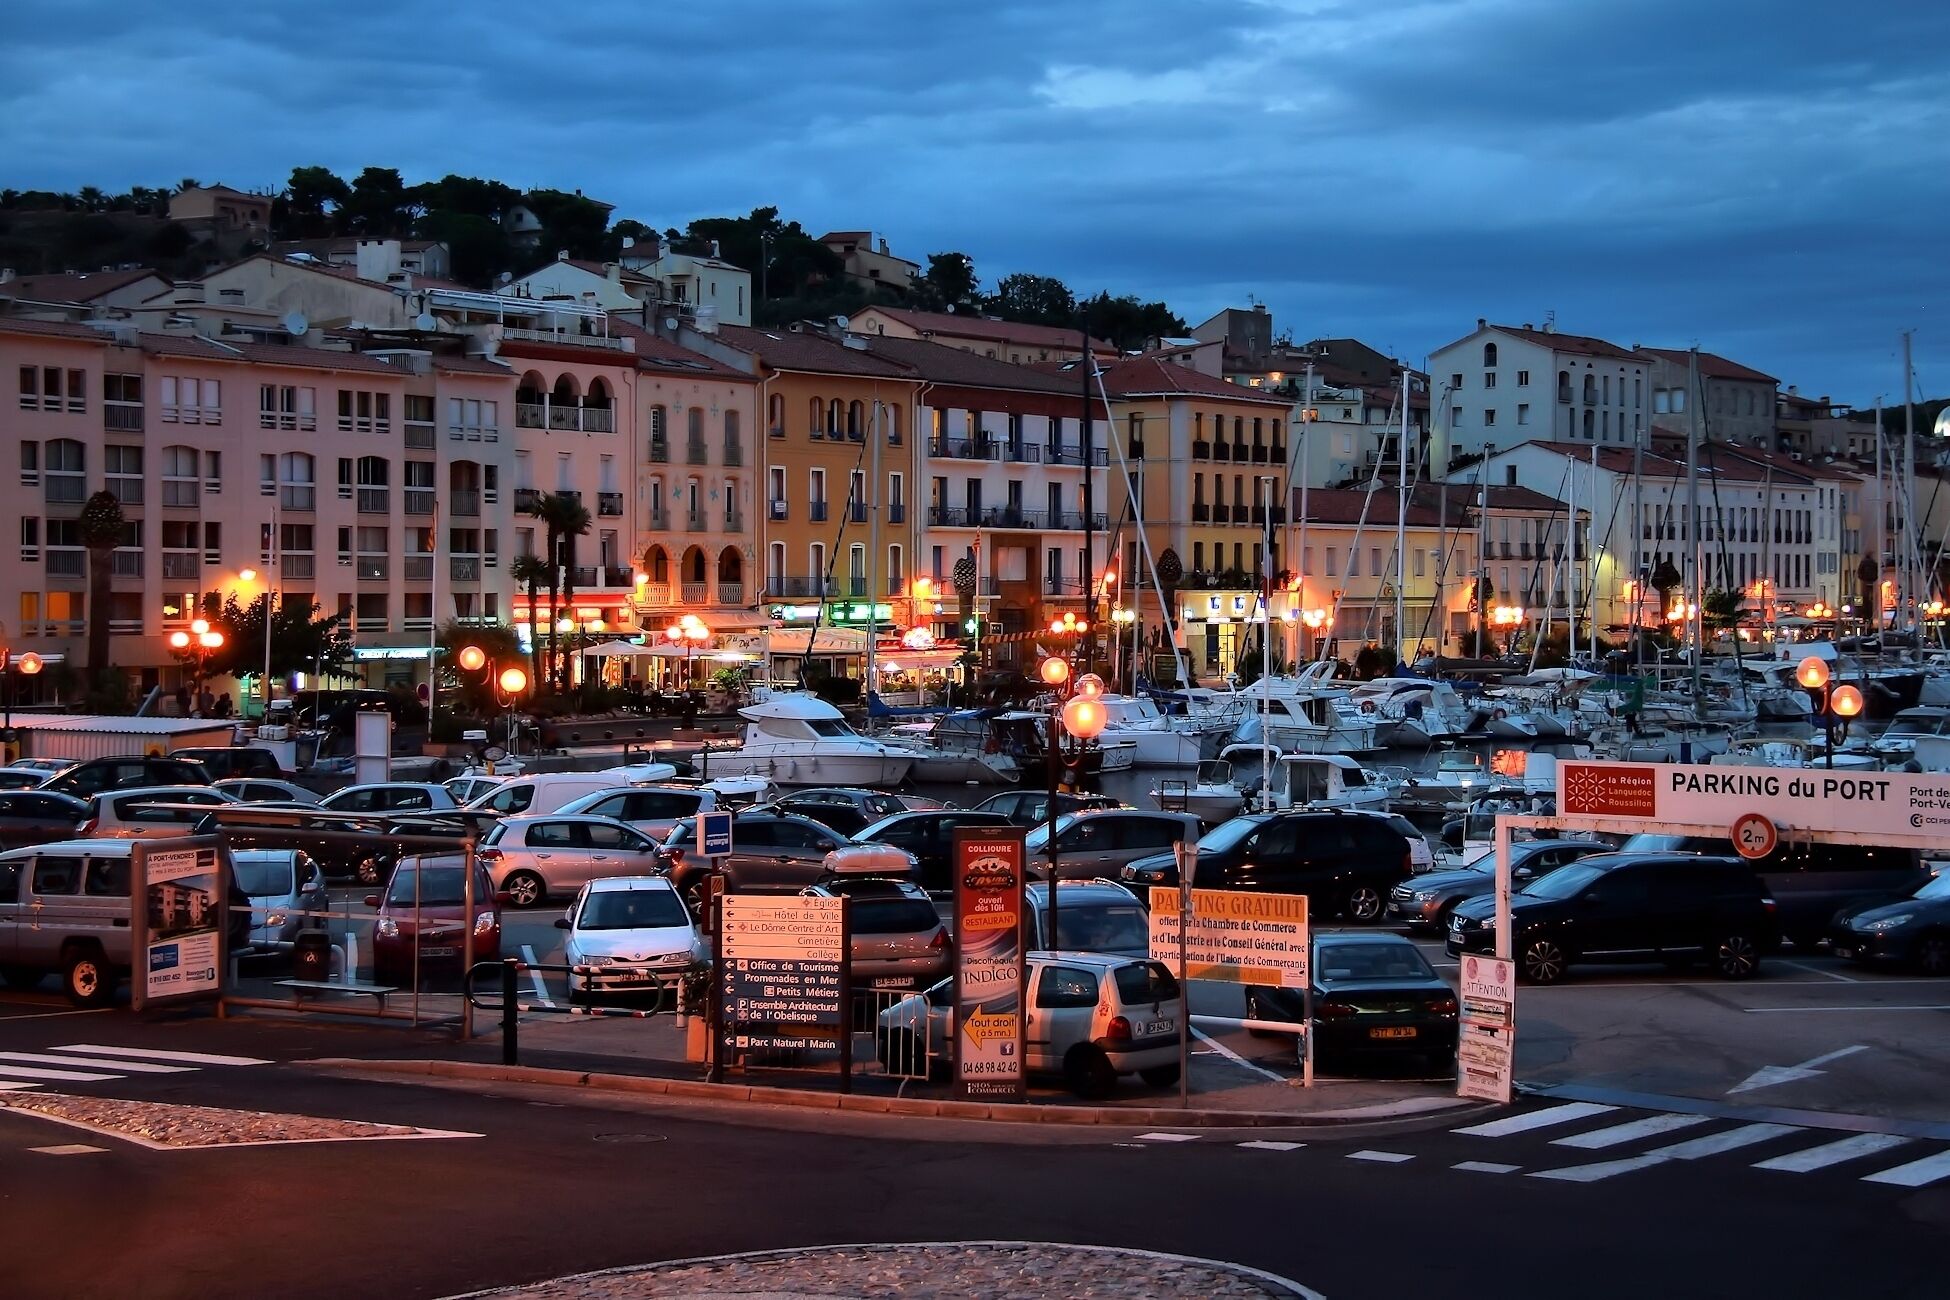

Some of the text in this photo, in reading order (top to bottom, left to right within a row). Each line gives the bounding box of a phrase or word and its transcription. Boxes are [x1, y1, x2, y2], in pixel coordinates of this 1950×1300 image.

[1608, 776, 1652, 786] la Région
[1672, 772, 1890, 801] PARKING du PORT
[1608, 787, 1652, 797] Languedoc
[1910, 786, 1933, 797] Port
[1608, 798, 1652, 807] Roussillon
[967, 845, 1012, 853] COLLIOURE
[154, 852, 195, 862] PORT-VENDRES
[813, 898, 839, 909] Église
[974, 904, 1005, 912] dès 10H
[1231, 897, 1301, 918] GRATUIT
[774, 910, 839, 920] Hôtel de Ville
[965, 915, 1014, 927] RESTAURANT
[1159, 916, 1178, 927] offert
[1202, 917, 1239, 931] Chambre
[1240, 919, 1251, 931] de
[1252, 920, 1297, 934] Commerce
[750, 923, 760, 932] Le
[761, 923, 786, 932] Dôme
[787, 924, 814, 933] Centre
[797, 936, 839, 945] Cimetière
[1151, 932, 1305, 953] et d'Indstrie et le Conseil Général avec
[806, 949, 839, 961] Collège
[1151, 949, 1306, 969] la partication de l'Union des Commerçants
[750, 960, 839, 972] Office de Tourisme
[967, 957, 1014, 966] Discothèque
[744, 973, 839, 985] Promenades en Mer
[776, 986, 839, 998] Petits Métiers
[1467, 981, 1507, 998] ATTENTION
[750, 1000, 839, 1012] Ensemble Architectural
[750, 1010, 818, 1022] de l'Obelisque
[970, 1018, 1015, 1027] Tout droit
[750, 1038, 836, 1049] Parc Naturel Marin
[963, 1061, 1017, 1073] 04 68 98 42 42
